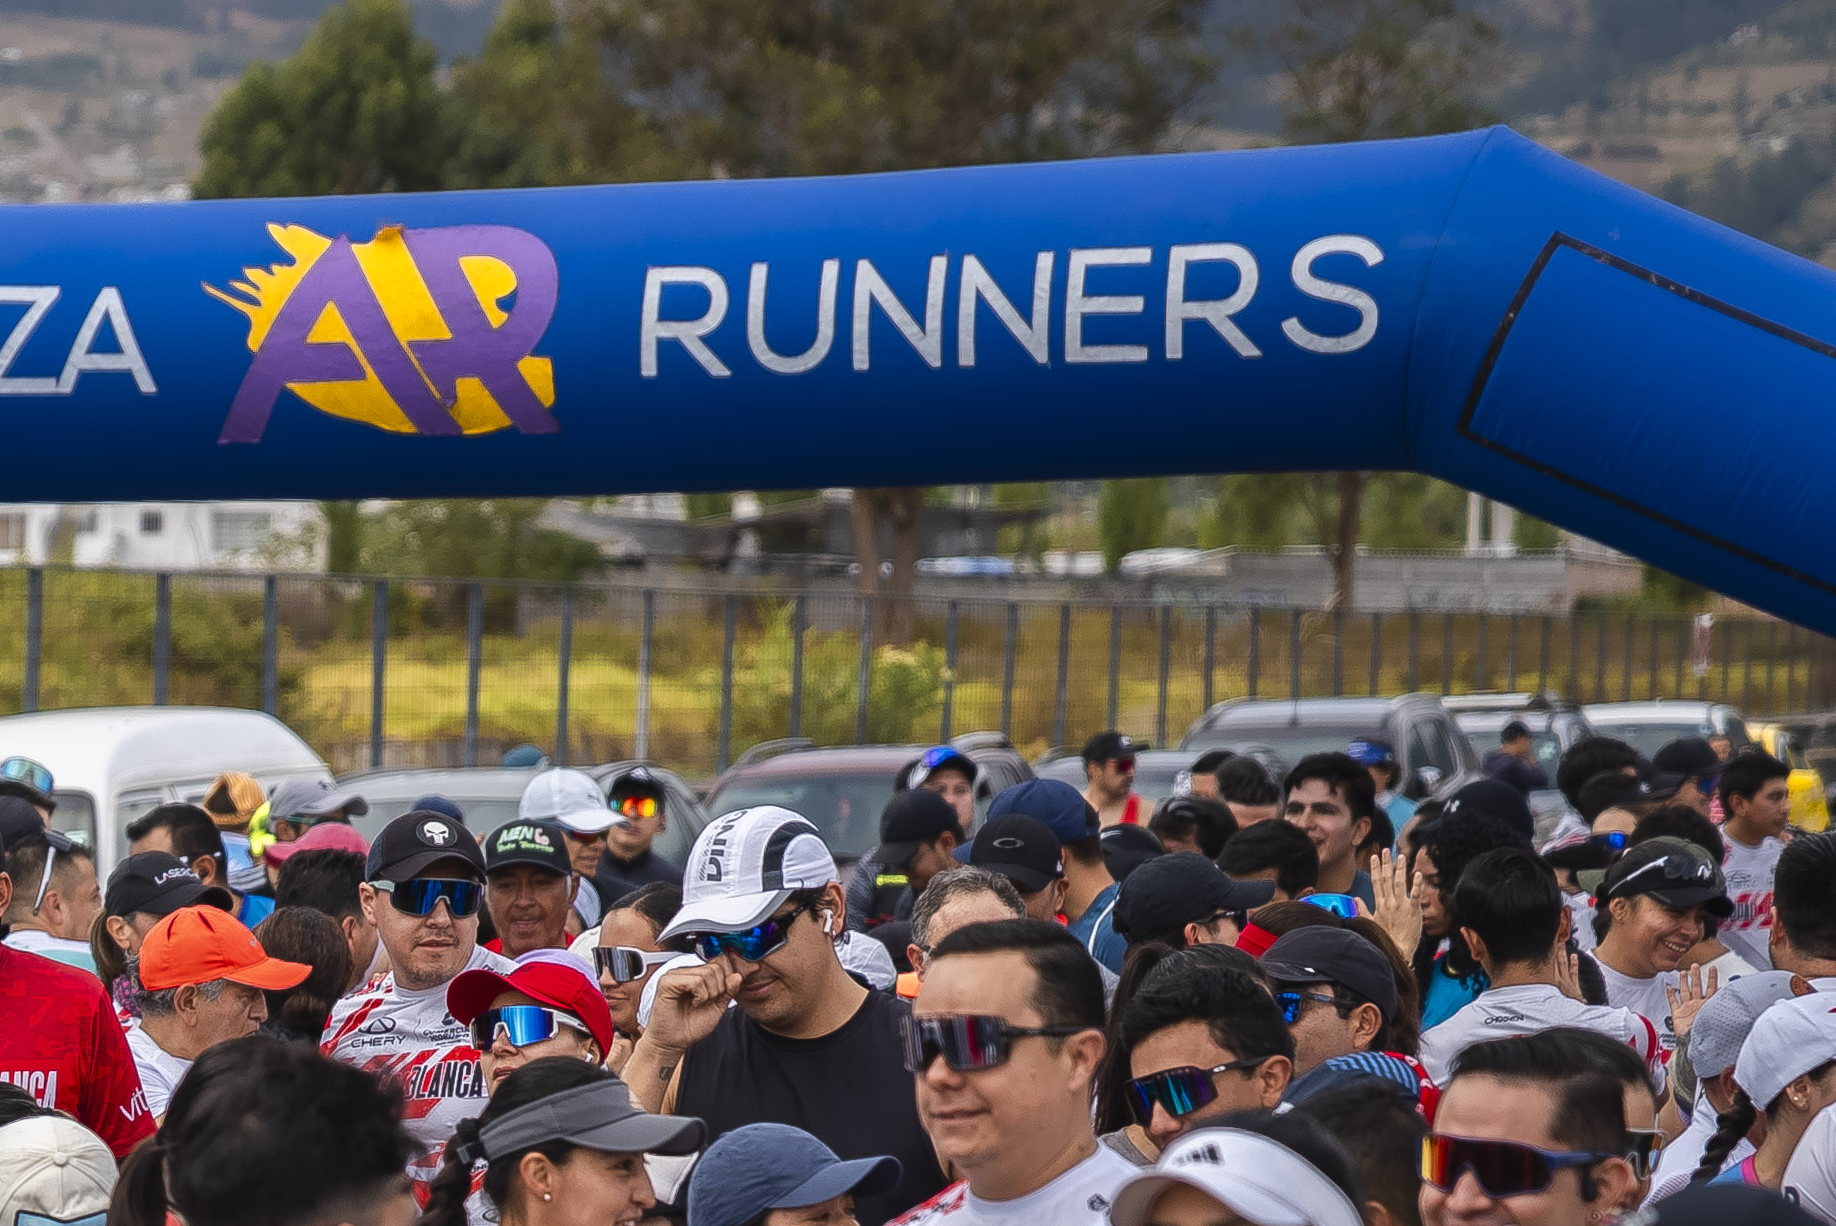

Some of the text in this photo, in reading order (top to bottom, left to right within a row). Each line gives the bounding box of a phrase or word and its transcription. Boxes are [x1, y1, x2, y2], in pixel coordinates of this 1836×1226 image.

[639, 233, 1386, 379] RUNNERS
[351, 1034, 406, 1048] CHERY
[406, 1055, 484, 1099] BLANCA
